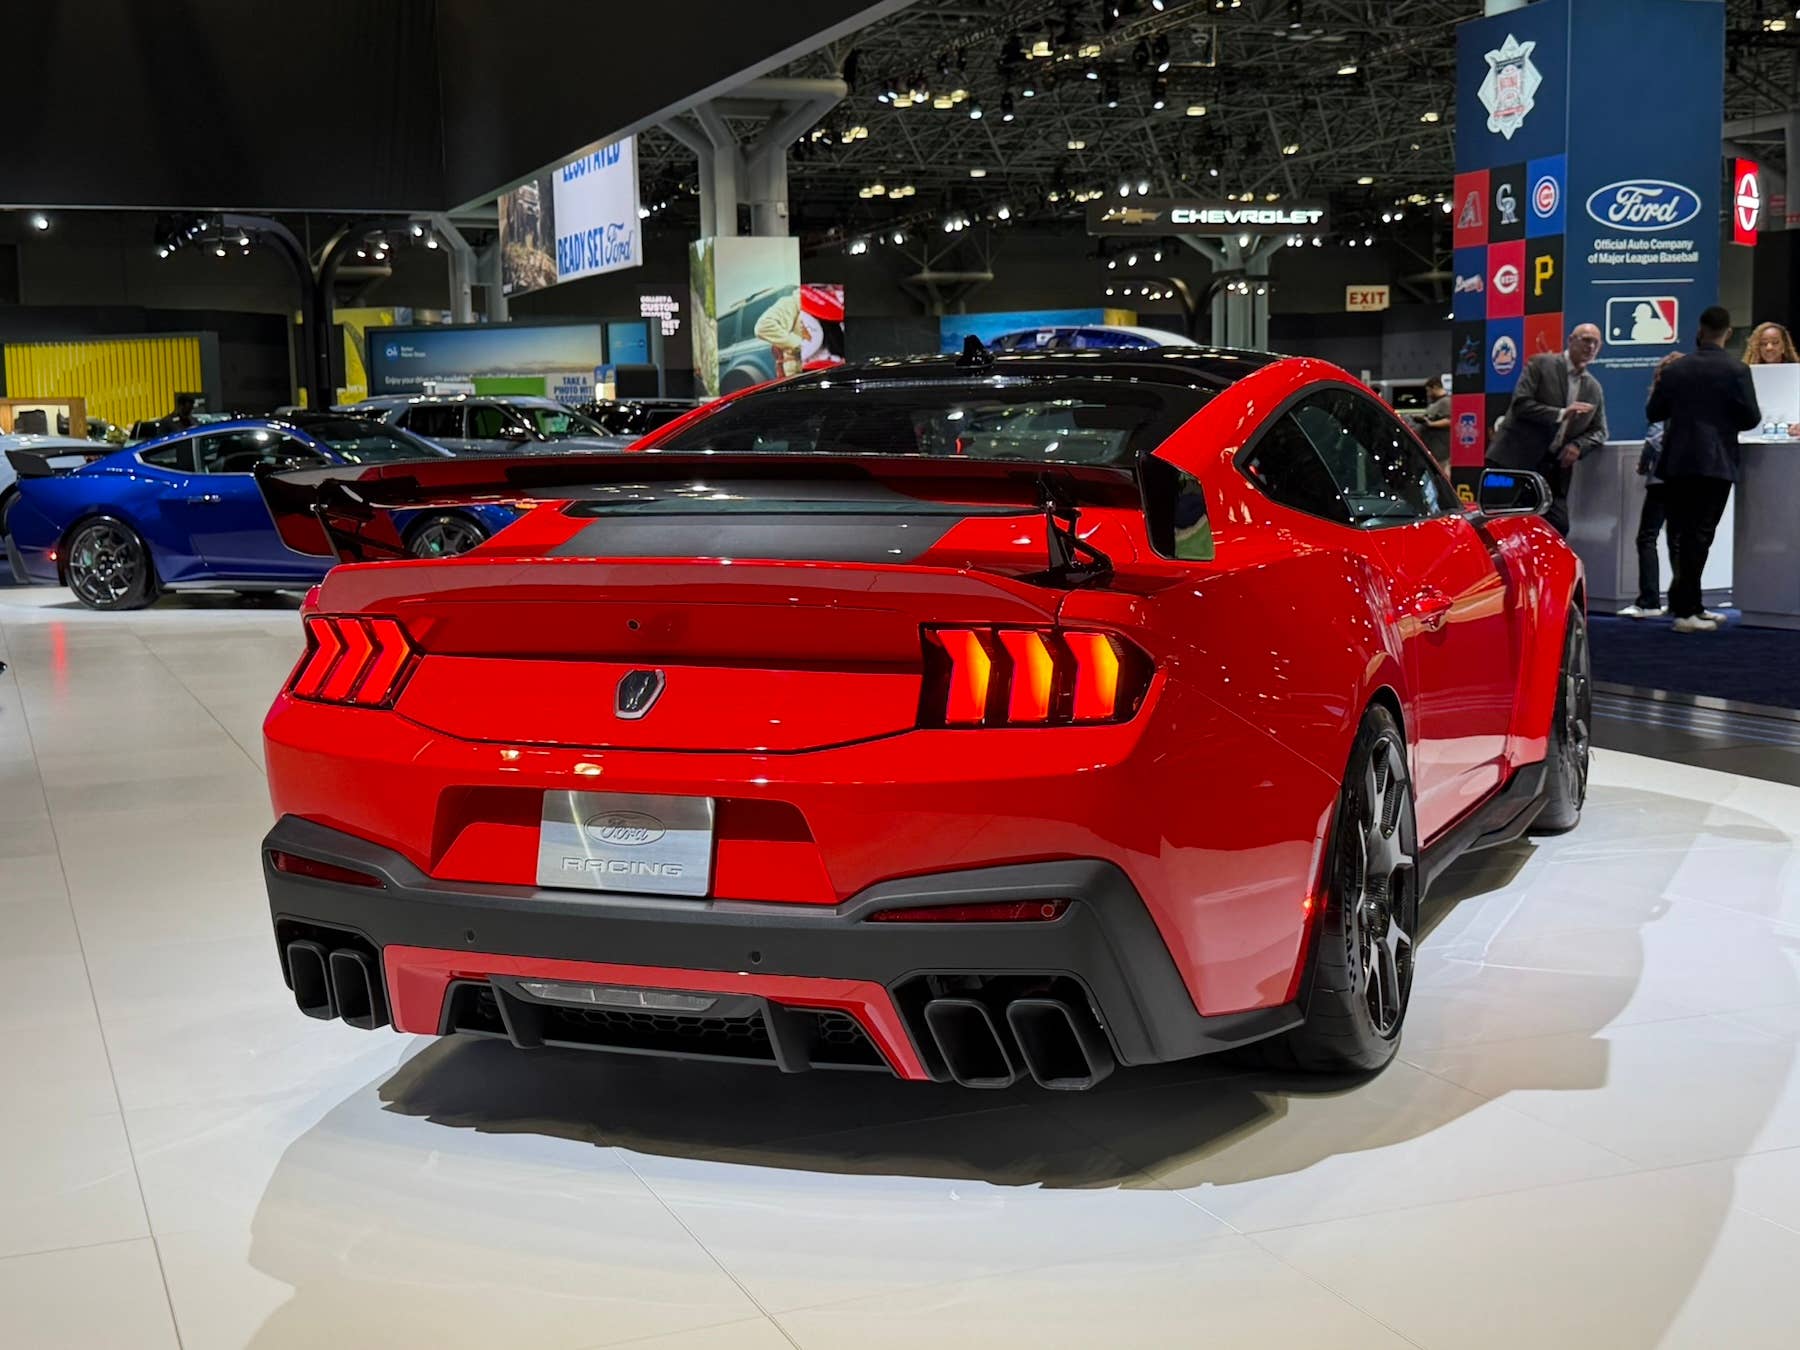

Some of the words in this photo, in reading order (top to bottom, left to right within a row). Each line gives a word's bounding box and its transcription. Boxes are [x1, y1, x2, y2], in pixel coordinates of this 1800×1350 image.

[1608, 187, 1680, 222] Ford
[1171, 209, 1323, 224] CHEVROLET
[558, 231, 587, 276] READY
[588, 226, 605, 269] SET
[605, 222, 633, 264] Ford
[1594, 239, 1627, 251] Official
[1628, 239, 1650, 251] Auto
[1650, 239, 1695, 252] Company
[1587, 252, 1599, 264] of
[1599, 252, 1625, 265] Major
[1626, 252, 1659, 265] League
[1660, 251, 1699, 264] Baseball
[1534, 255, 1555, 296] P
[1349, 290, 1386, 305] EXIT
[640, 302, 680, 313] CUSTOM
[563, 376, 580, 385] TAKE
[582, 376, 588, 385] A
[554, 386, 579, 395] PHOTO
[601, 817, 649, 842] Ford
[562, 857, 683, 878] RACING
